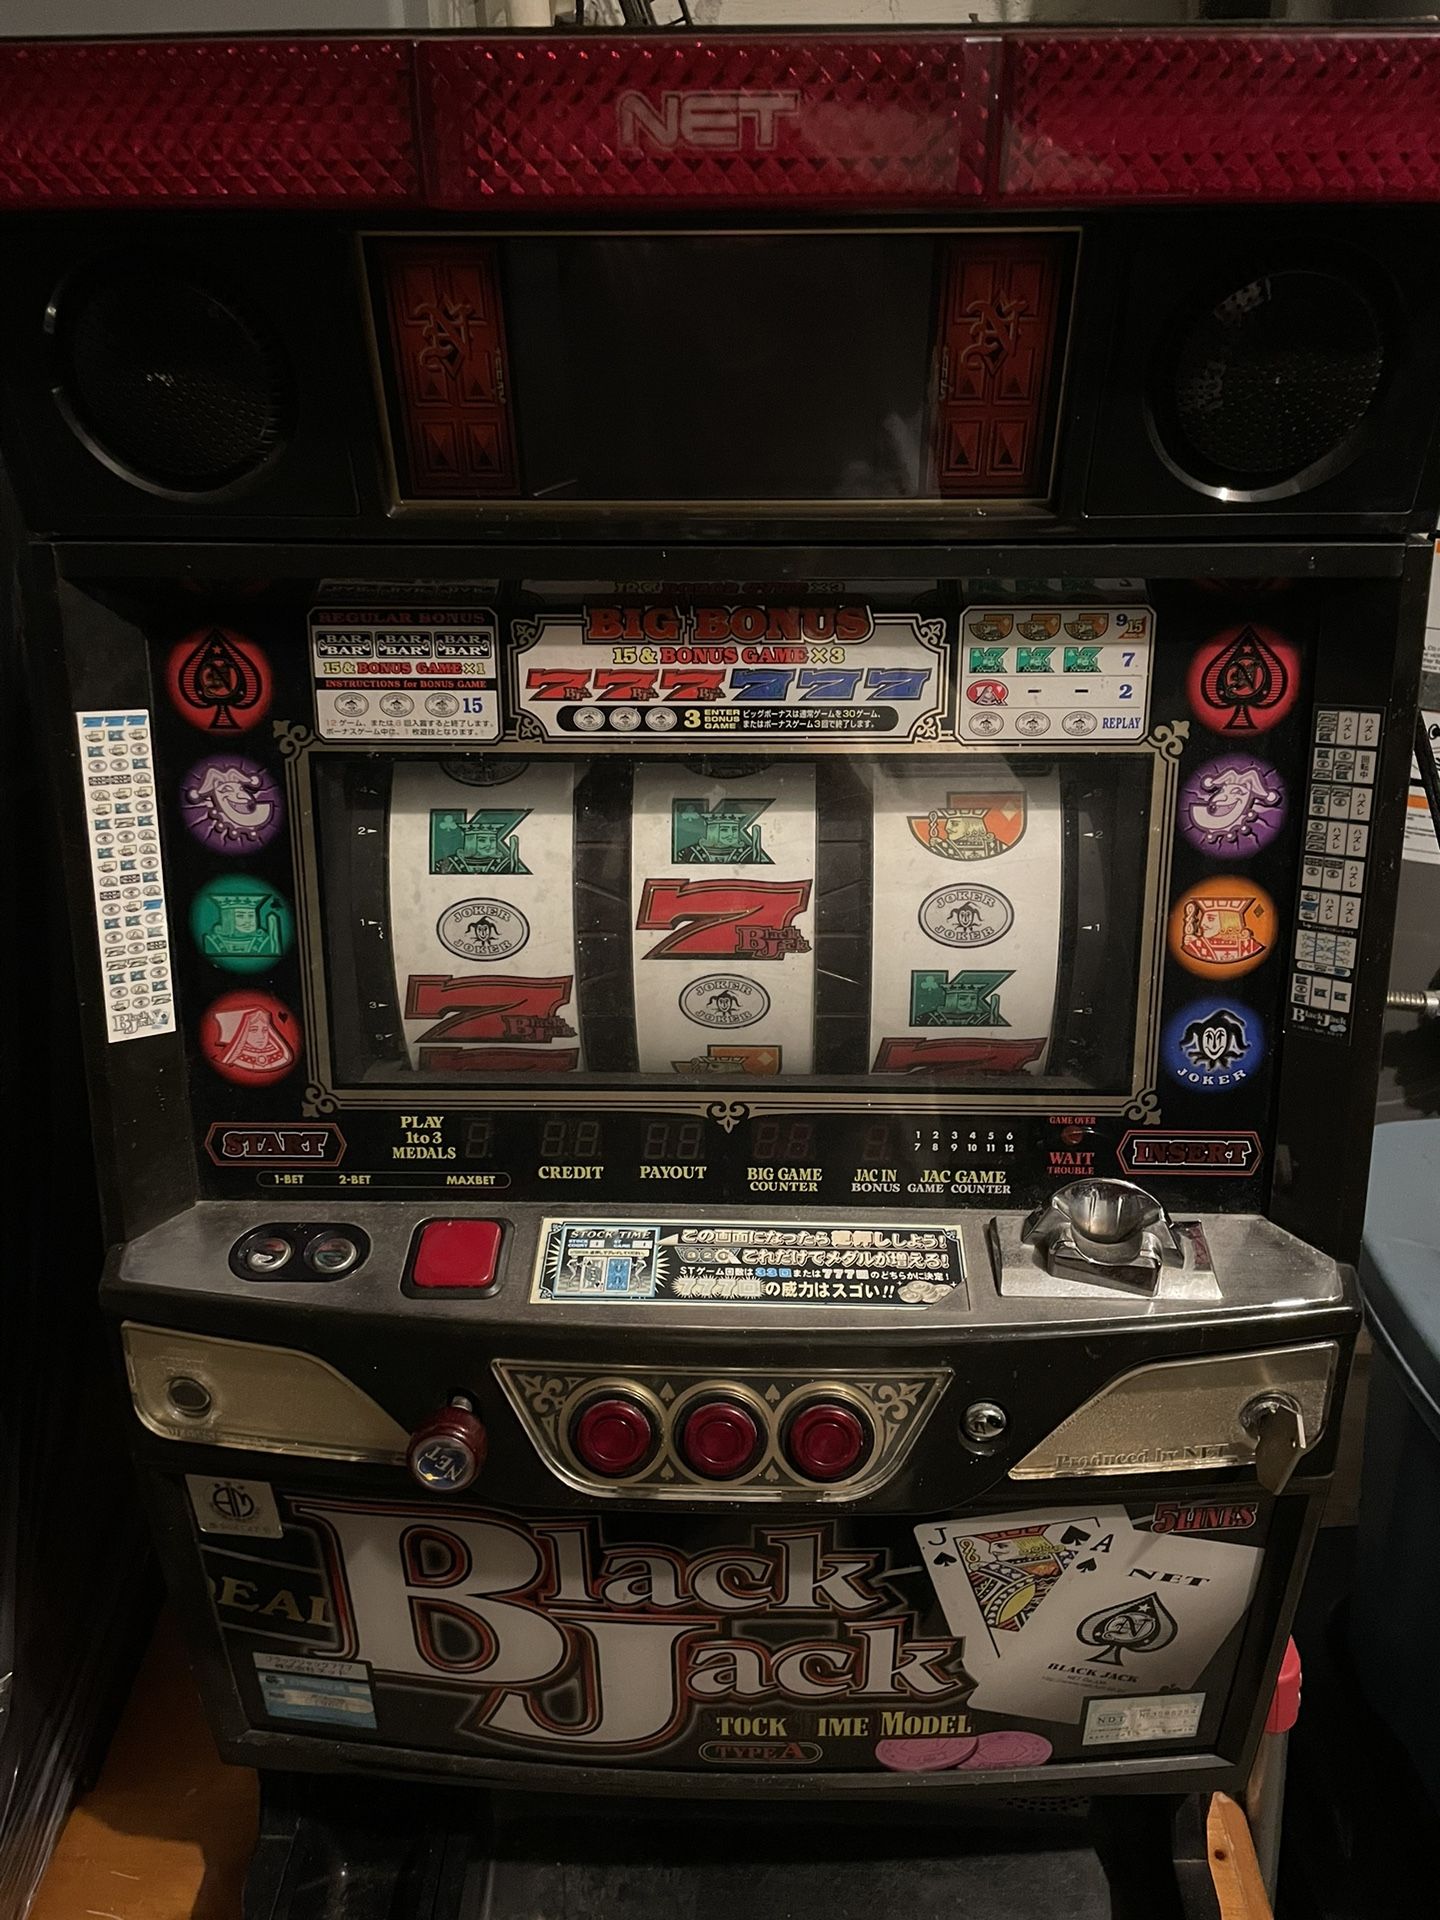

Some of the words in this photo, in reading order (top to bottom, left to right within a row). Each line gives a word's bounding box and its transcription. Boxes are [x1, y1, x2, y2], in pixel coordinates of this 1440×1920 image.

[618, 91, 800, 150] NET
[319, 612, 413, 623] REGULAR
[419, 612, 485, 623] BONUS
[587, 606, 680, 640] BIG
[695, 606, 870, 640] BONUS
[1116, 614, 1127, 626] 9
[326, 634, 362, 644] BAR
[385, 634, 421, 644] BAR
[444, 634, 480, 644] BAR
[327, 646, 364, 655] BAR
[385, 646, 423, 655] BAR
[445, 646, 482, 656] BAR
[613, 647, 639, 664] 15
[640, 648, 657, 664] &
[660, 647, 737, 664] BONUS
[741, 647, 808, 664] GAME
[1122, 653, 1135, 667] 7
[324, 662, 340, 674] 15
[343, 662, 355, 674] &
[357, 662, 412, 674] BONUS
[416, 662, 462, 674] GAME
[325, 679, 400, 688] INSTRUCTIONS
[404, 679, 417, 688] for
[420, 679, 454, 688] BONUS
[457, 680, 487, 688] GAME
[526, 668, 592, 701] 7
[593, 668, 659, 701] 7
[659, 668, 726, 701] 7
[729, 668, 797, 700] 7
[796, 668, 864, 700] 7
[864, 668, 932, 700] 7
[1119, 684, 1132, 699] 2
[463, 697, 483, 713] 15
[683, 709, 701, 728] 3
[1102, 717, 1141, 729] REPLAY
[358, 827, 366, 835] 2
[937, 890, 995, 909] JOKER
[454, 906, 510, 922] JOKER
[936, 925, 995, 941] JOKER
[454, 939, 512, 954] JOKER
[696, 981, 752, 996] JOKER
[695, 1011, 752, 1023] JOKER
[1177, 1068, 1246, 1085] JOKER
[400, 1116, 445, 1129] PLAY
[1075, 1117, 1096, 1125] OVER
[915, 1131, 921, 1139] 1
[932, 1131, 939, 1139] 2
[951, 1131, 958, 1140] 3
[969, 1131, 976, 1140] 4
[987, 1132, 994, 1140] 5
[1006, 1132, 1013, 1140] 6
[222, 1131, 328, 1158] START
[914, 1143, 921, 1151] 7
[932, 1143, 938, 1151] 8
[951, 1143, 957, 1151] 9
[967, 1143, 977, 1152] 10
[986, 1144, 995, 1152] 11
[1004, 1144, 1014, 1152] 12
[392, 1147, 456, 1160] MEDALS
[1050, 1152, 1095, 1165] WAIT
[1132, 1140, 1251, 1166] INSERT
[538, 1166, 604, 1180] CREDIT
[639, 1166, 707, 1180] PAYOUT
[747, 1167, 774, 1181] BIG
[777, 1168, 823, 1182] GAME
[854, 1169, 878, 1182] JAC
[881, 1169, 897, 1182] IN
[920, 1170, 951, 1183] JAC
[954, 1170, 1006, 1184] GAME
[1047, 1166, 1094, 1175] TROUBLE
[274, 1174, 304, 1185] 1-BET
[338, 1174, 372, 1185] 2-BET
[446, 1175, 496, 1186] MAXBET
[749, 1181, 819, 1193] COUNTER
[851, 1183, 900, 1193] BONUS
[907, 1184, 944, 1193] GAME
[950, 1184, 1011, 1194] COUNTER
[570, 1231, 614, 1239] STOCK
[619, 1231, 651, 1239] TIME
[1054, 1450, 1148, 1469] Produced
[1155, 1448, 1178, 1463] by
[1184, 1443, 1230, 1461] NET
[425, 1446, 463, 1481] NET
[928, 1527, 948, 1546] J
[1090, 1533, 1115, 1553] A
[1129, 1568, 1210, 1588] NET
[286, 1496, 886, 1684] Black
[478, 1609, 968, 1745] Jack
[1047, 1662, 1097, 1677] BLACK
[1100, 1671, 1139, 1684] JACK
[714, 1716, 788, 1738] TOCK
[817, 1716, 870, 1738] IME
[880, 1710, 973, 1737] MODEL
